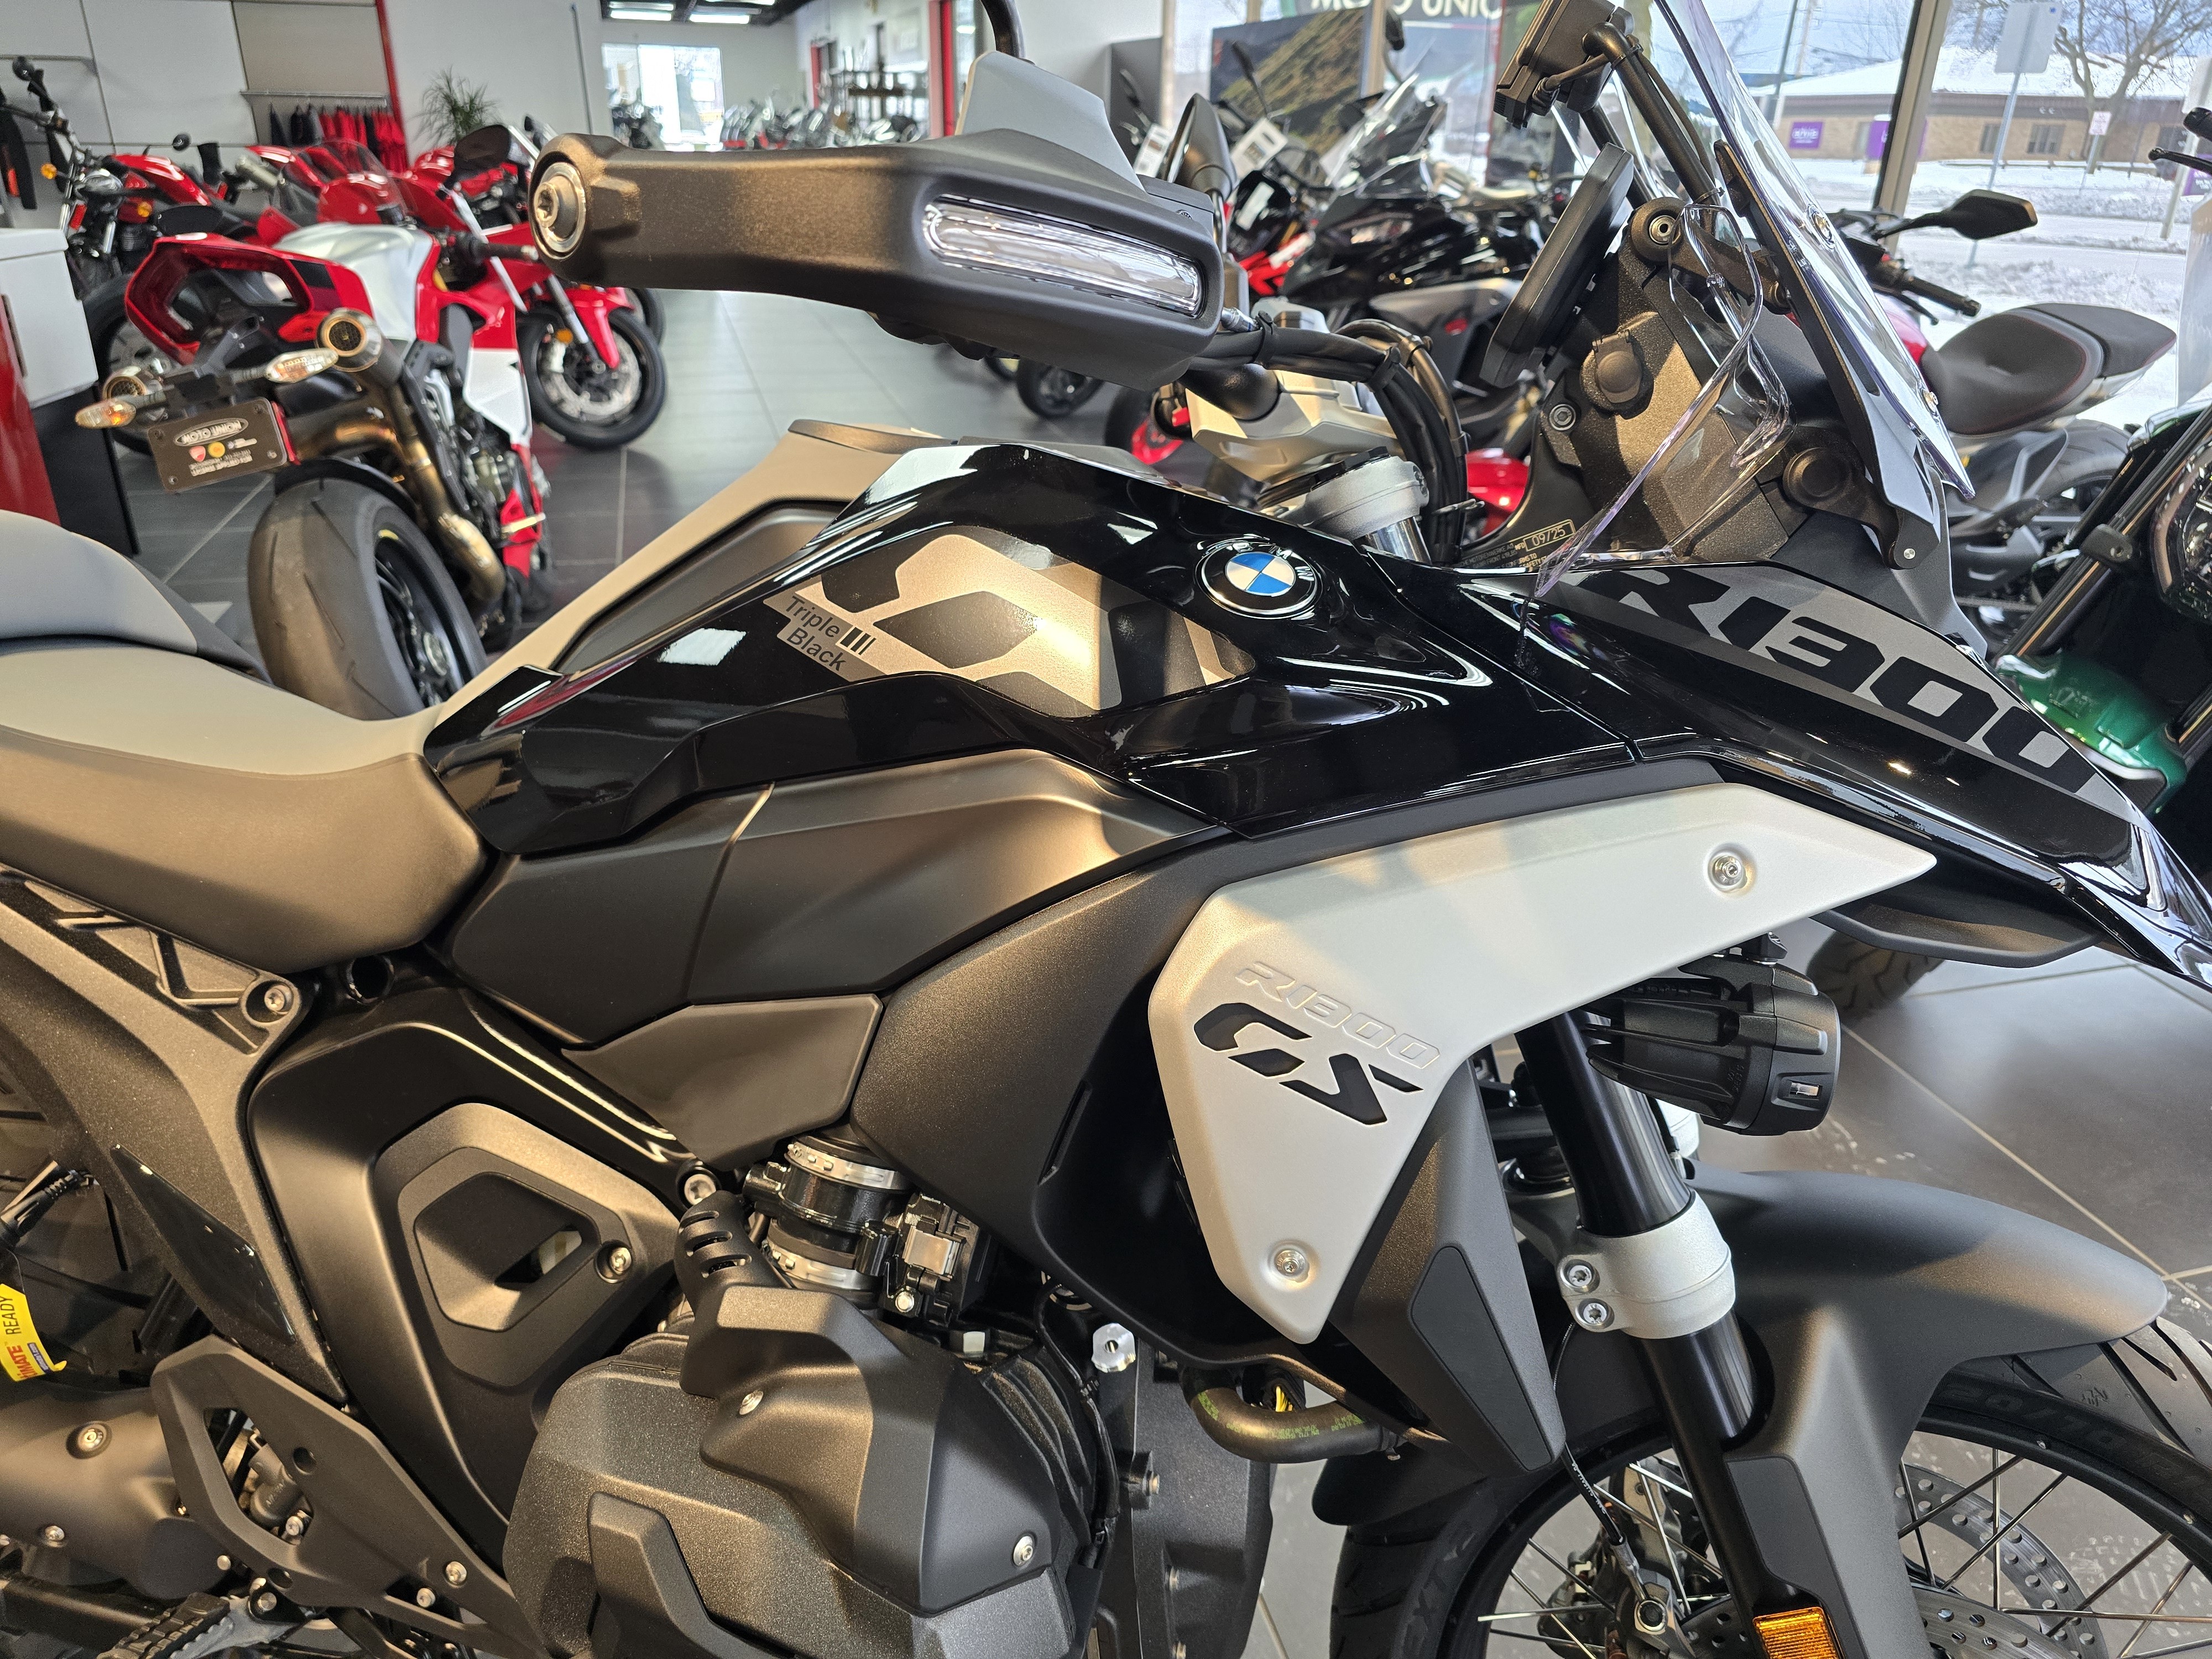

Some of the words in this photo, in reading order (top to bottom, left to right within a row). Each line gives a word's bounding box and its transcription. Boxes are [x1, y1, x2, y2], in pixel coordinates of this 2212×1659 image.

[1531, 525, 1566, 547] 09/25
[785, 596, 840, 638] Triple
[786, 627, 847, 672] Black
[1193, 1002, 1425, 1126] GS
[0, 1296, 22, 1335] READY
